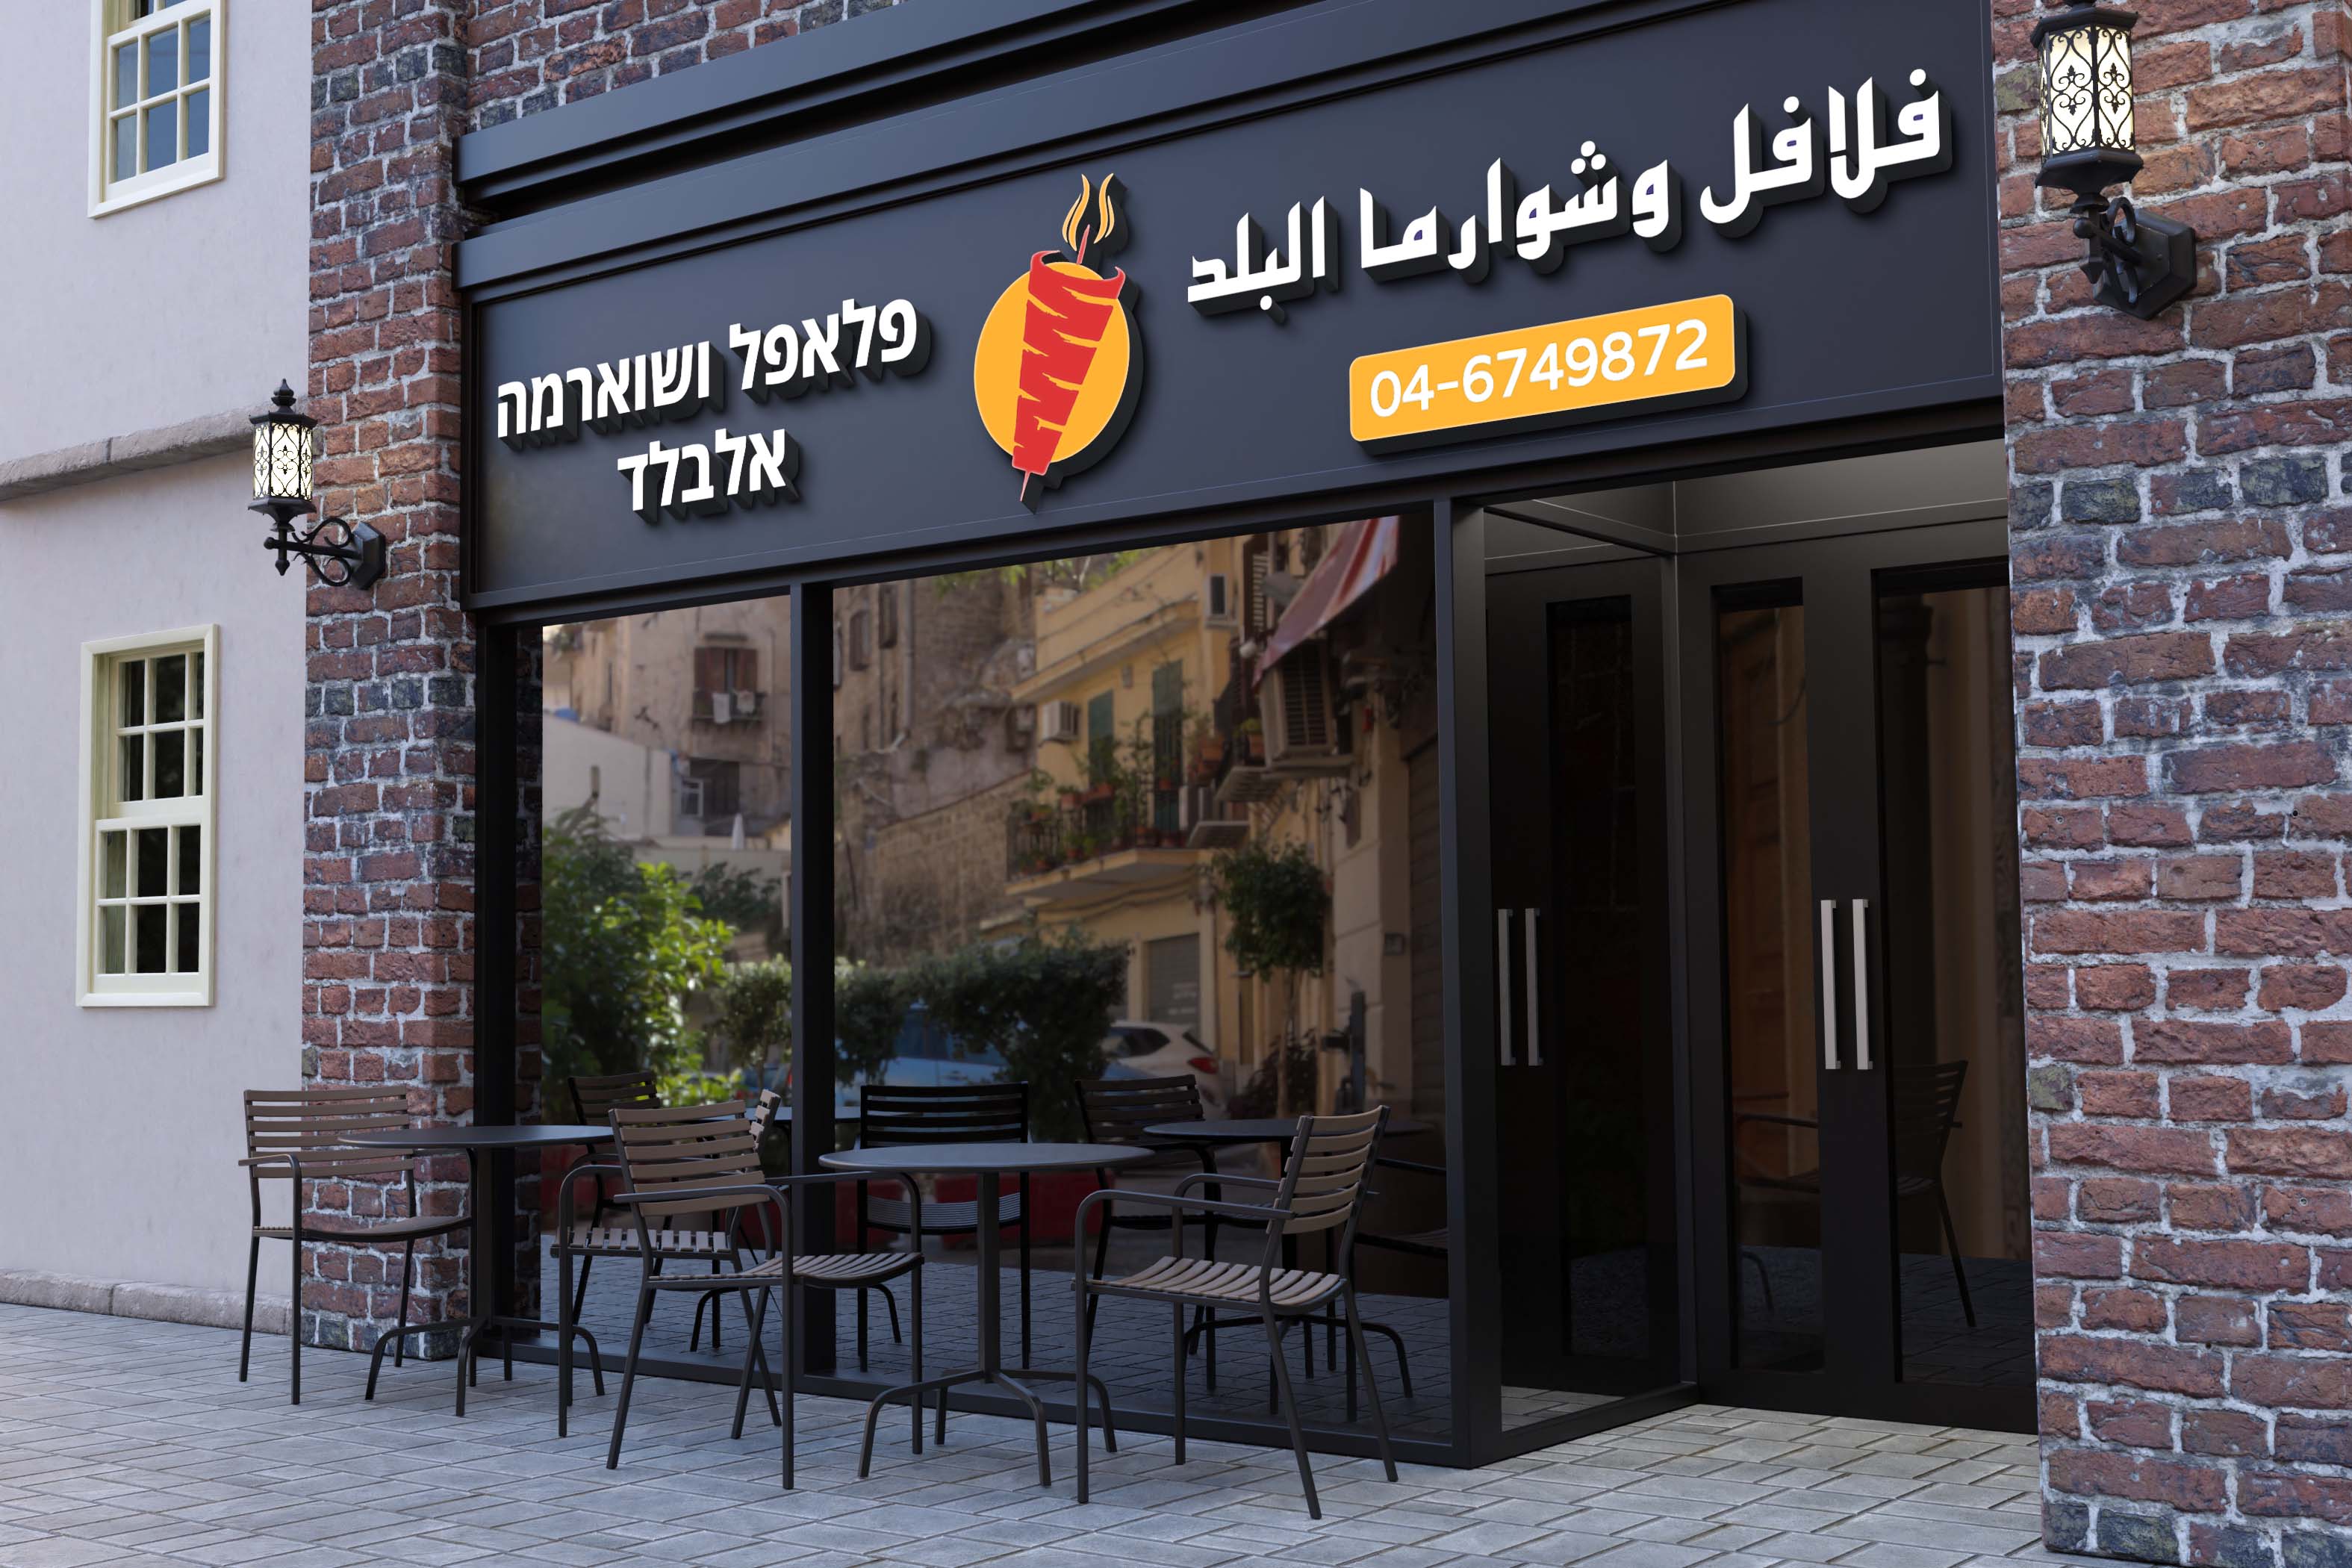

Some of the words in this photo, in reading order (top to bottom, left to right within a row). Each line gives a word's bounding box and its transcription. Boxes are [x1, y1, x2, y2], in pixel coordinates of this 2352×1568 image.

[1699, 69, 1941, 224] فلافل
[1187, 196, 1325, 311] البلد
[1360, 140, 1670, 270] وشوارما
[498, 340, 709, 438] ושוארמה
[729, 299, 917, 391] פלאפל
[1370, 319, 1708, 417] 04-6749872
[617, 429, 786, 511] אלבלד
